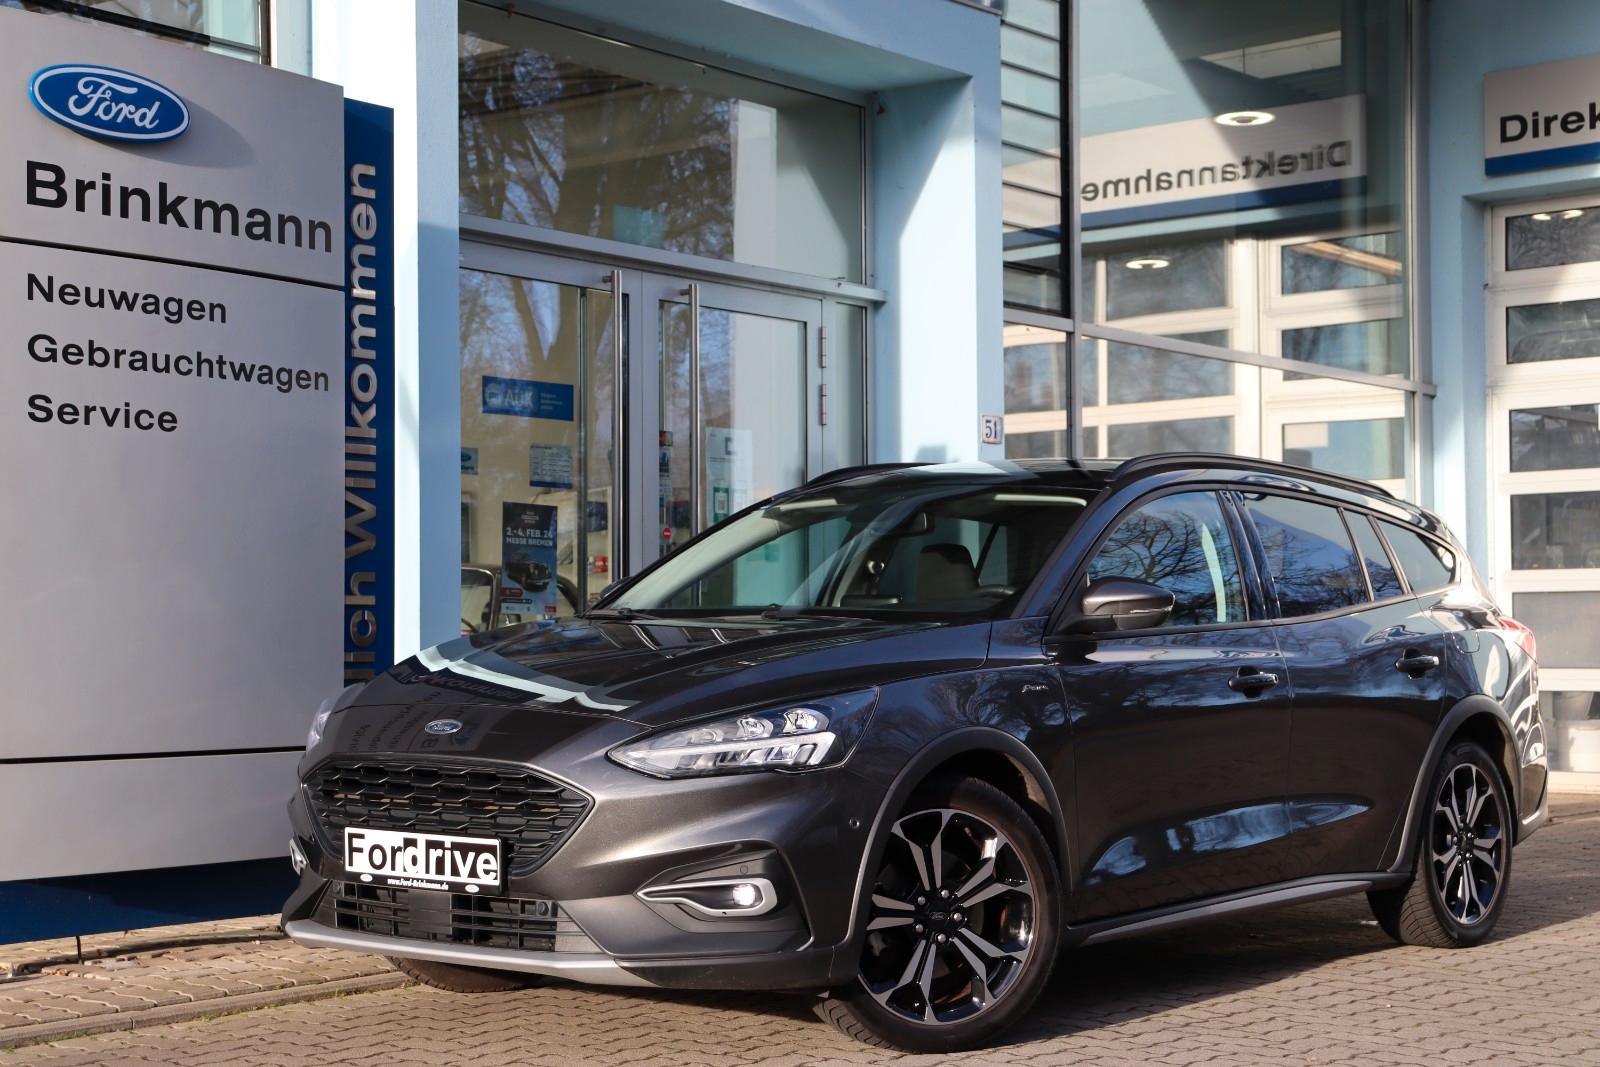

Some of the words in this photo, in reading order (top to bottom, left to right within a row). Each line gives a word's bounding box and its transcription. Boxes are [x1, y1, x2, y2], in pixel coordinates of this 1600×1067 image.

[68, 76, 161, 129] Ford
[26, 160, 332, 253] Brinkmann
[27, 273, 227, 323] Neuwagen
[27, 333, 330, 393] Gebrauchtwagen
[27, 393, 178, 432] Service
[985, 419, 998, 439] 51
[347, 831, 498, 881] Fordrive
